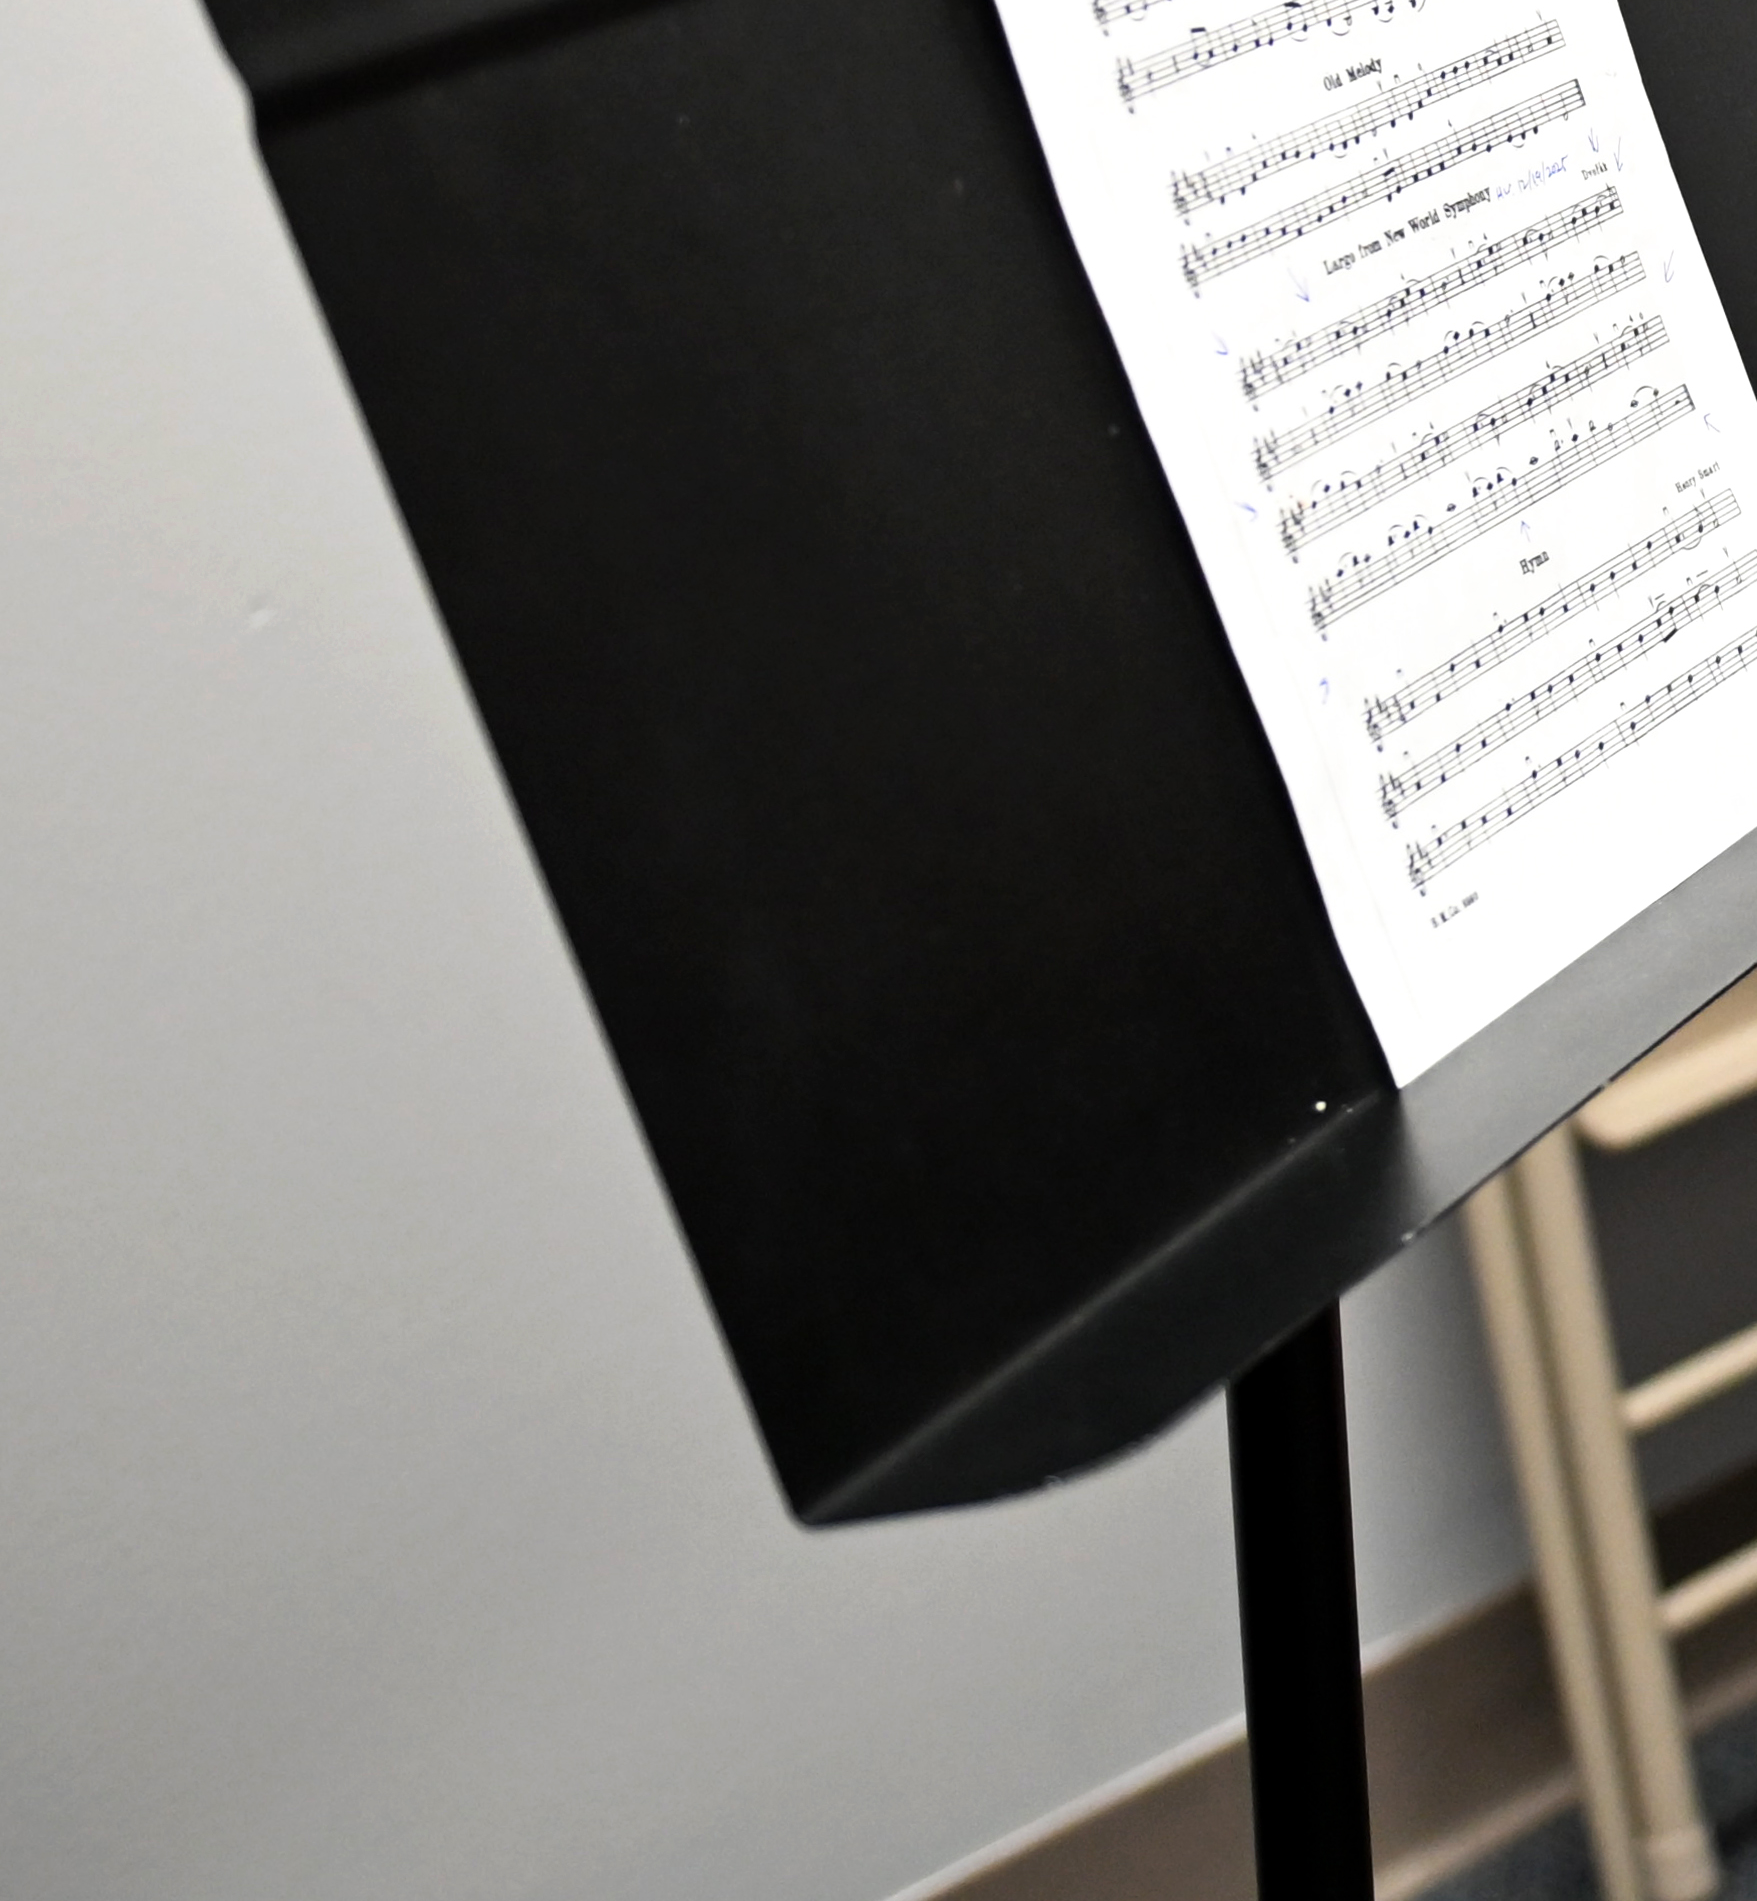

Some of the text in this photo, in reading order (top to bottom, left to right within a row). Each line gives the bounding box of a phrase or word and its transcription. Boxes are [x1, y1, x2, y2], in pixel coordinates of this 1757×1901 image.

[1323, 57, 1382, 91] Old Melody
[1323, 186, 1492, 275] Largo from New World Symphony
[1674, 461, 1721, 494] Henry Smart
[1519, 551, 1550, 575] Hymn
